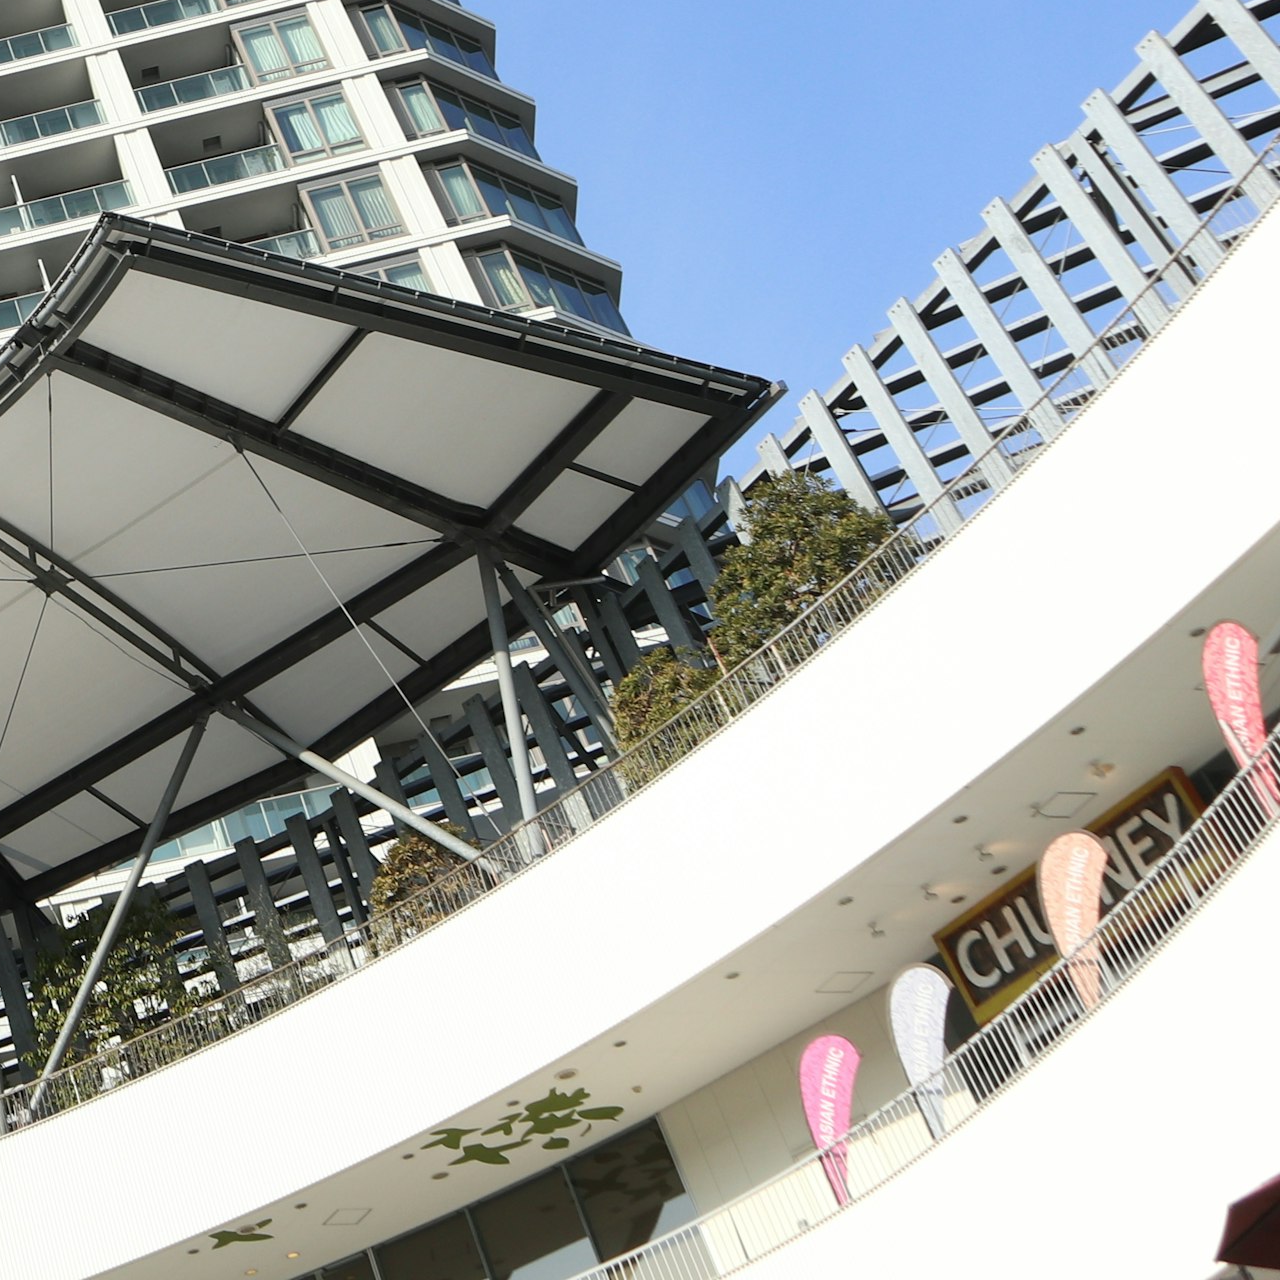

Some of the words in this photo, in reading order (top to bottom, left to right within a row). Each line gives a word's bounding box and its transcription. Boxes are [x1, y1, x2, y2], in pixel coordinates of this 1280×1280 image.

[1224, 636, 1243, 701] ETHNIC
[956, 793, 1183, 989] CHUNEY
[1064, 846, 1090, 905] ETHNIC
[820, 1046, 845, 1100] ETHNIC
[818, 1099, 837, 1145] ASIAN
